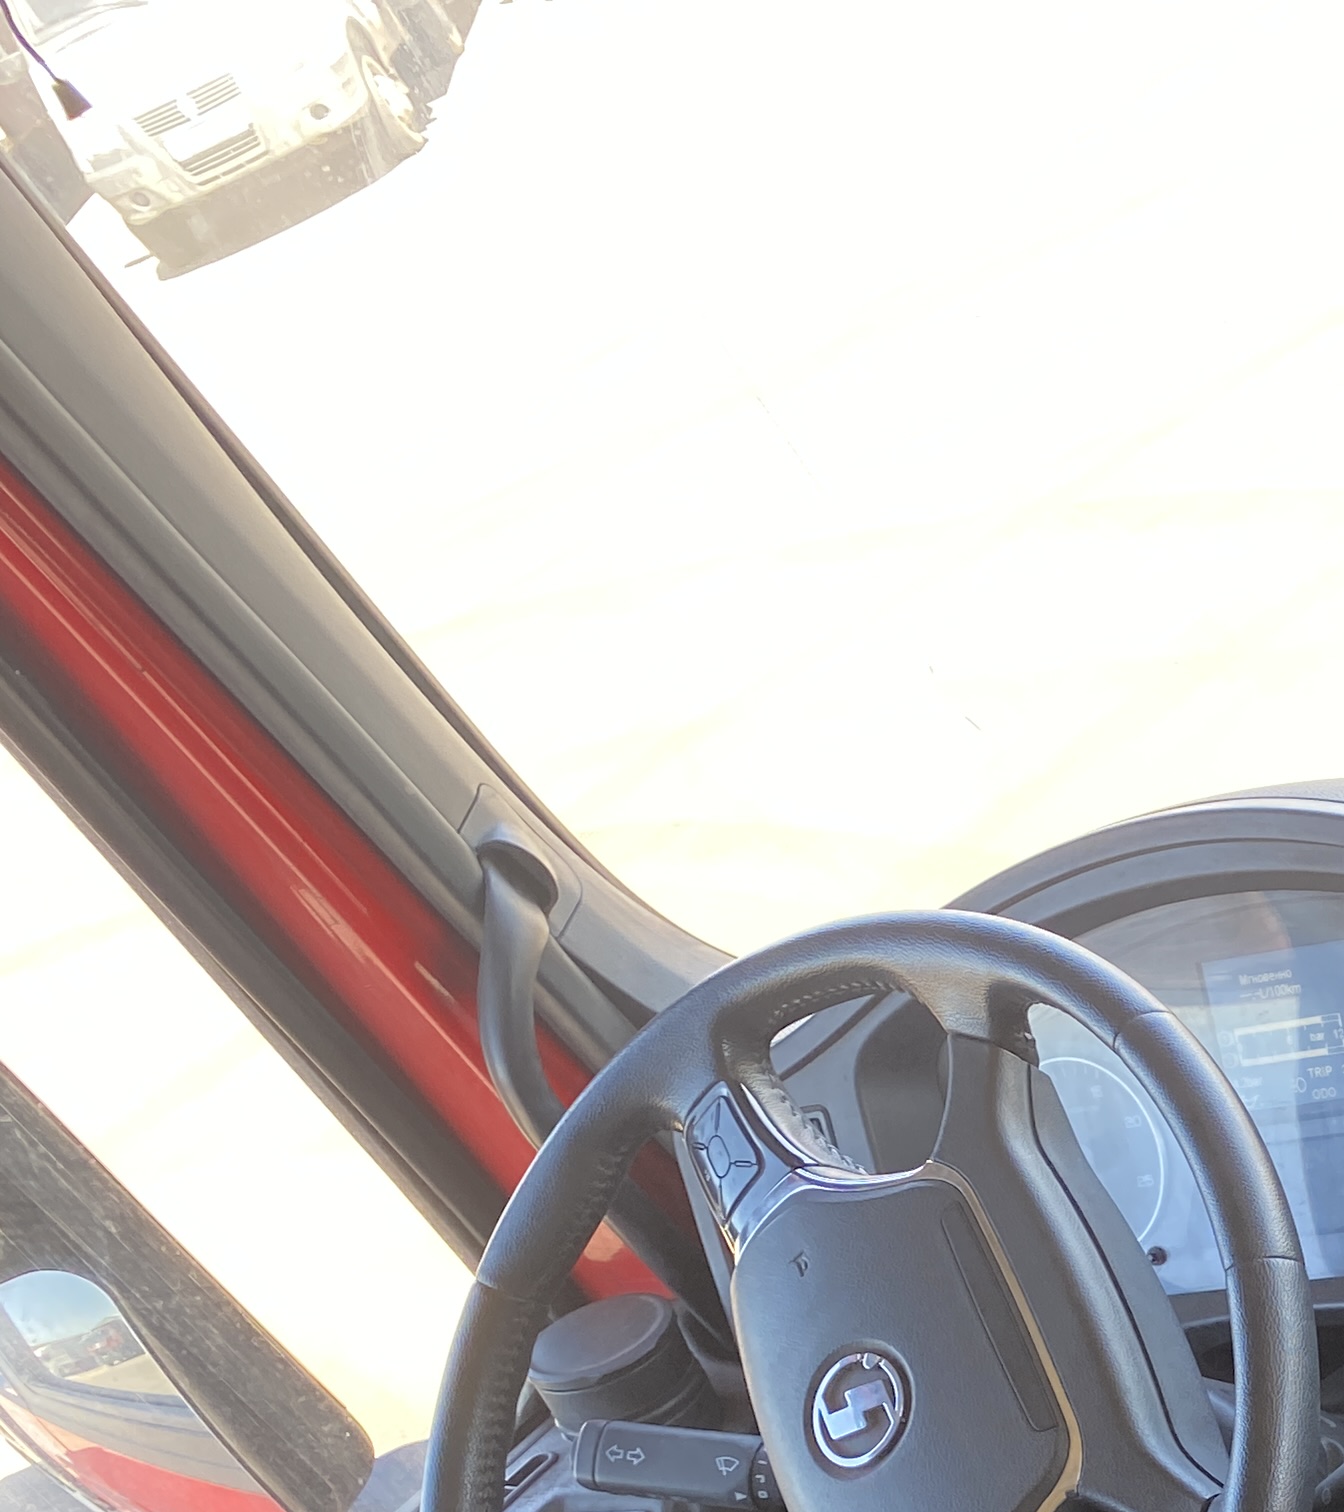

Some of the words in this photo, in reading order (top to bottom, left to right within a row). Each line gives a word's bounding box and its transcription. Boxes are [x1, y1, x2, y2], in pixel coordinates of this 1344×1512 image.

[1307, 1065, 1333, 1078] TRIP
[1312, 1087, 1337, 1099] ODO
[1124, 1114, 1142, 1129] 20
